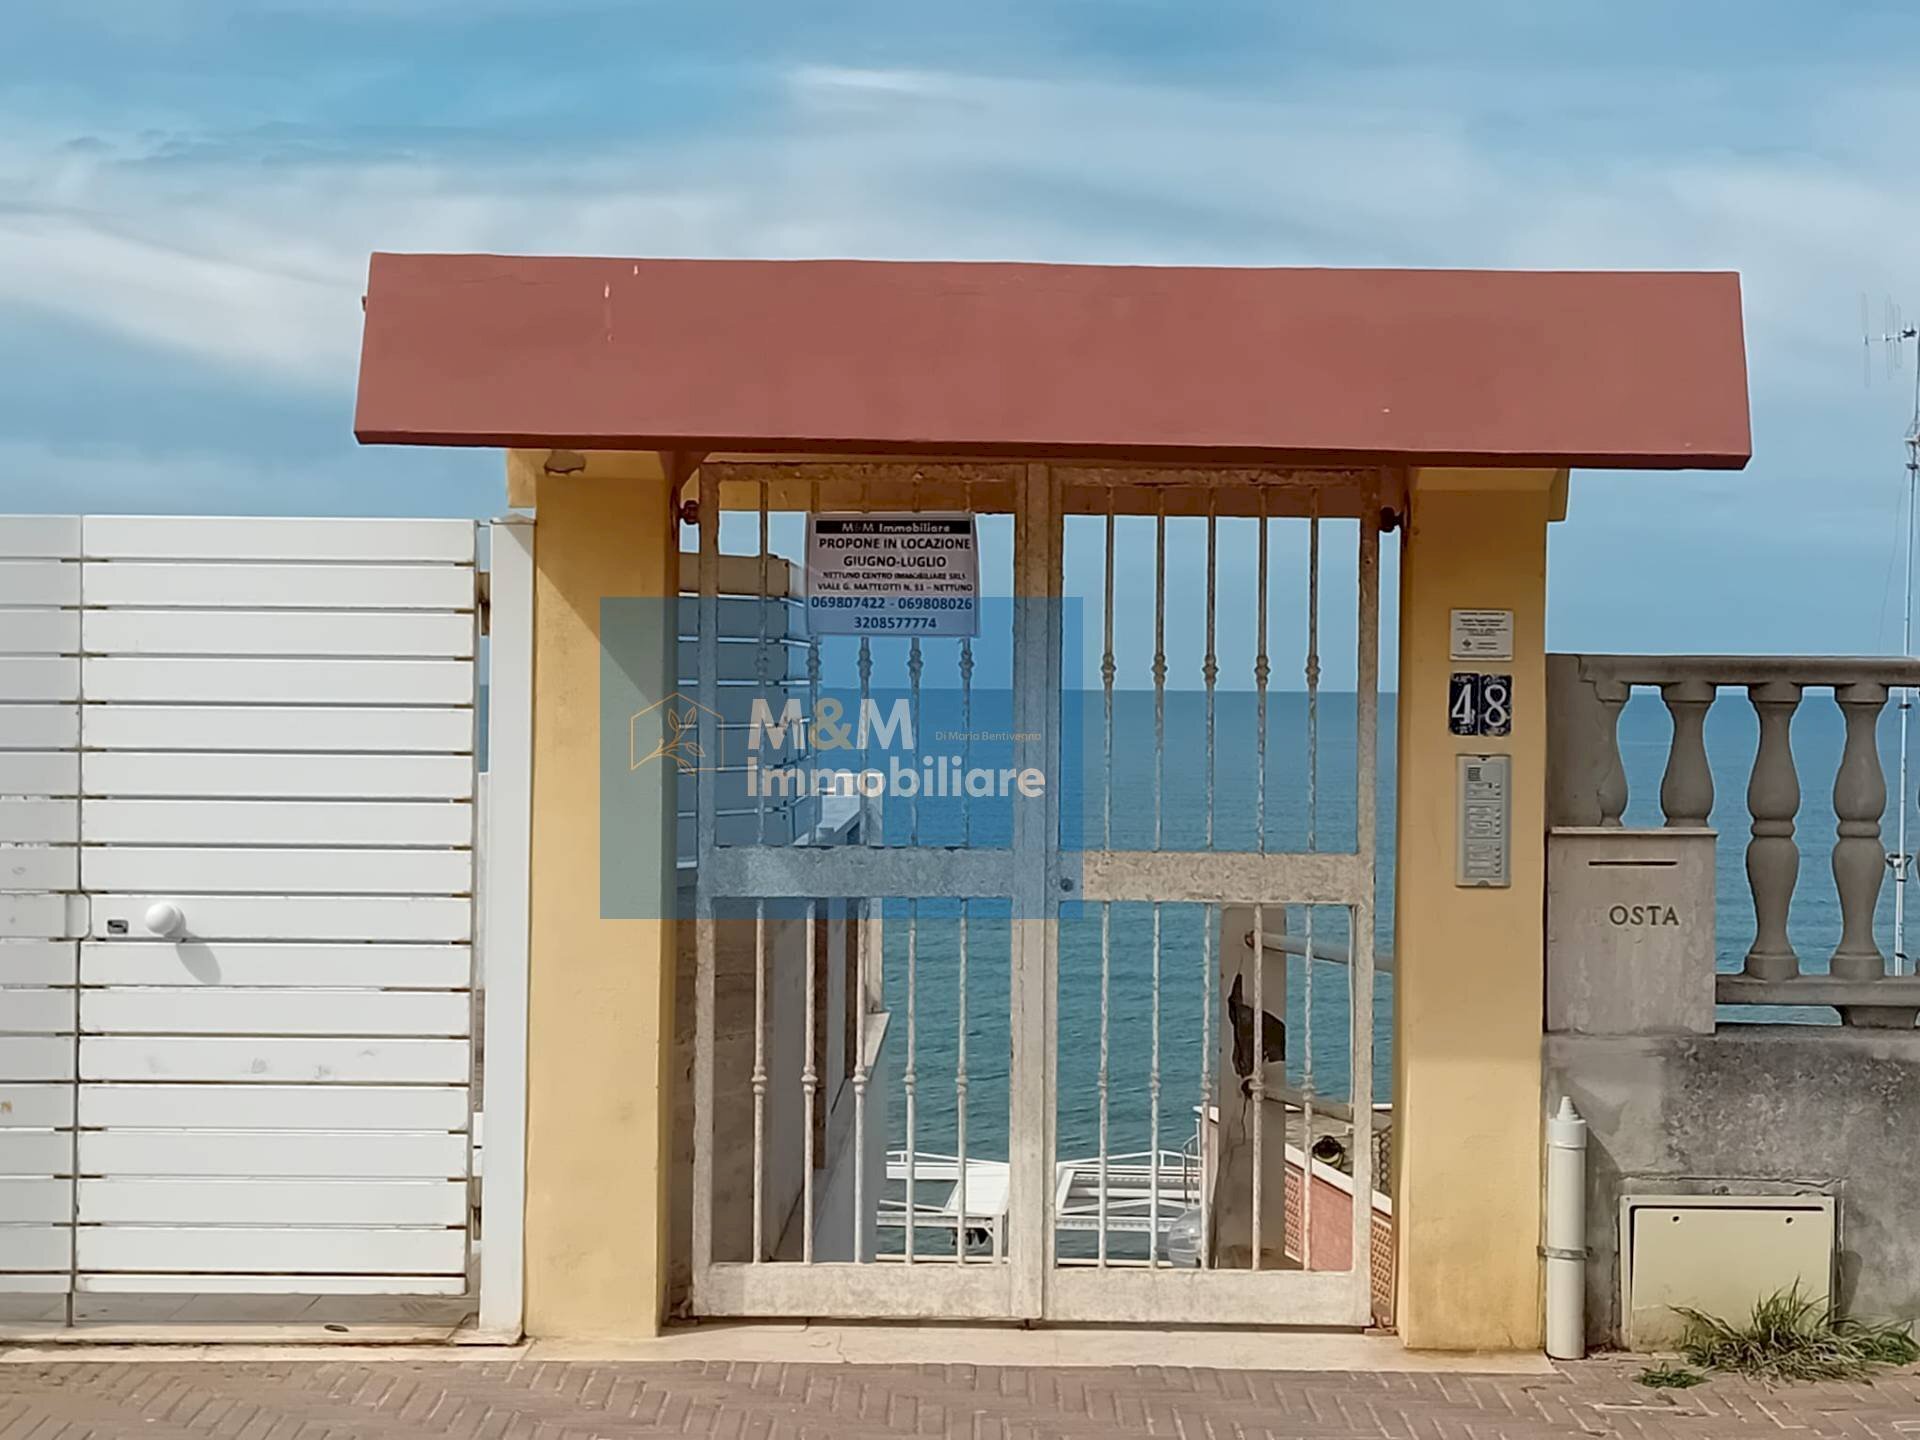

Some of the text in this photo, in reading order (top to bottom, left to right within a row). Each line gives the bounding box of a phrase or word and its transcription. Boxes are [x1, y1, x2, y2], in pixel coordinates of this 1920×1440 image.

[879, 522, 950, 533] Immobiliare
[819, 538, 971, 550] PROPONE IN LOCAZIONE
[843, 555, 947, 568] GIUGNO-LUGLIO
[862, 571, 893, 580] CENTRO
[817, 583, 841, 591] VIALE
[853, 583, 902, 592] MATTEOTTI
[933, 583, 973, 593] NETTUNO
[811, 596, 885, 609] 069807422
[898, 597, 973, 610] 069808026
[854, 616, 937, 629] 3208577774
[1451, 683, 1507, 727] 48
